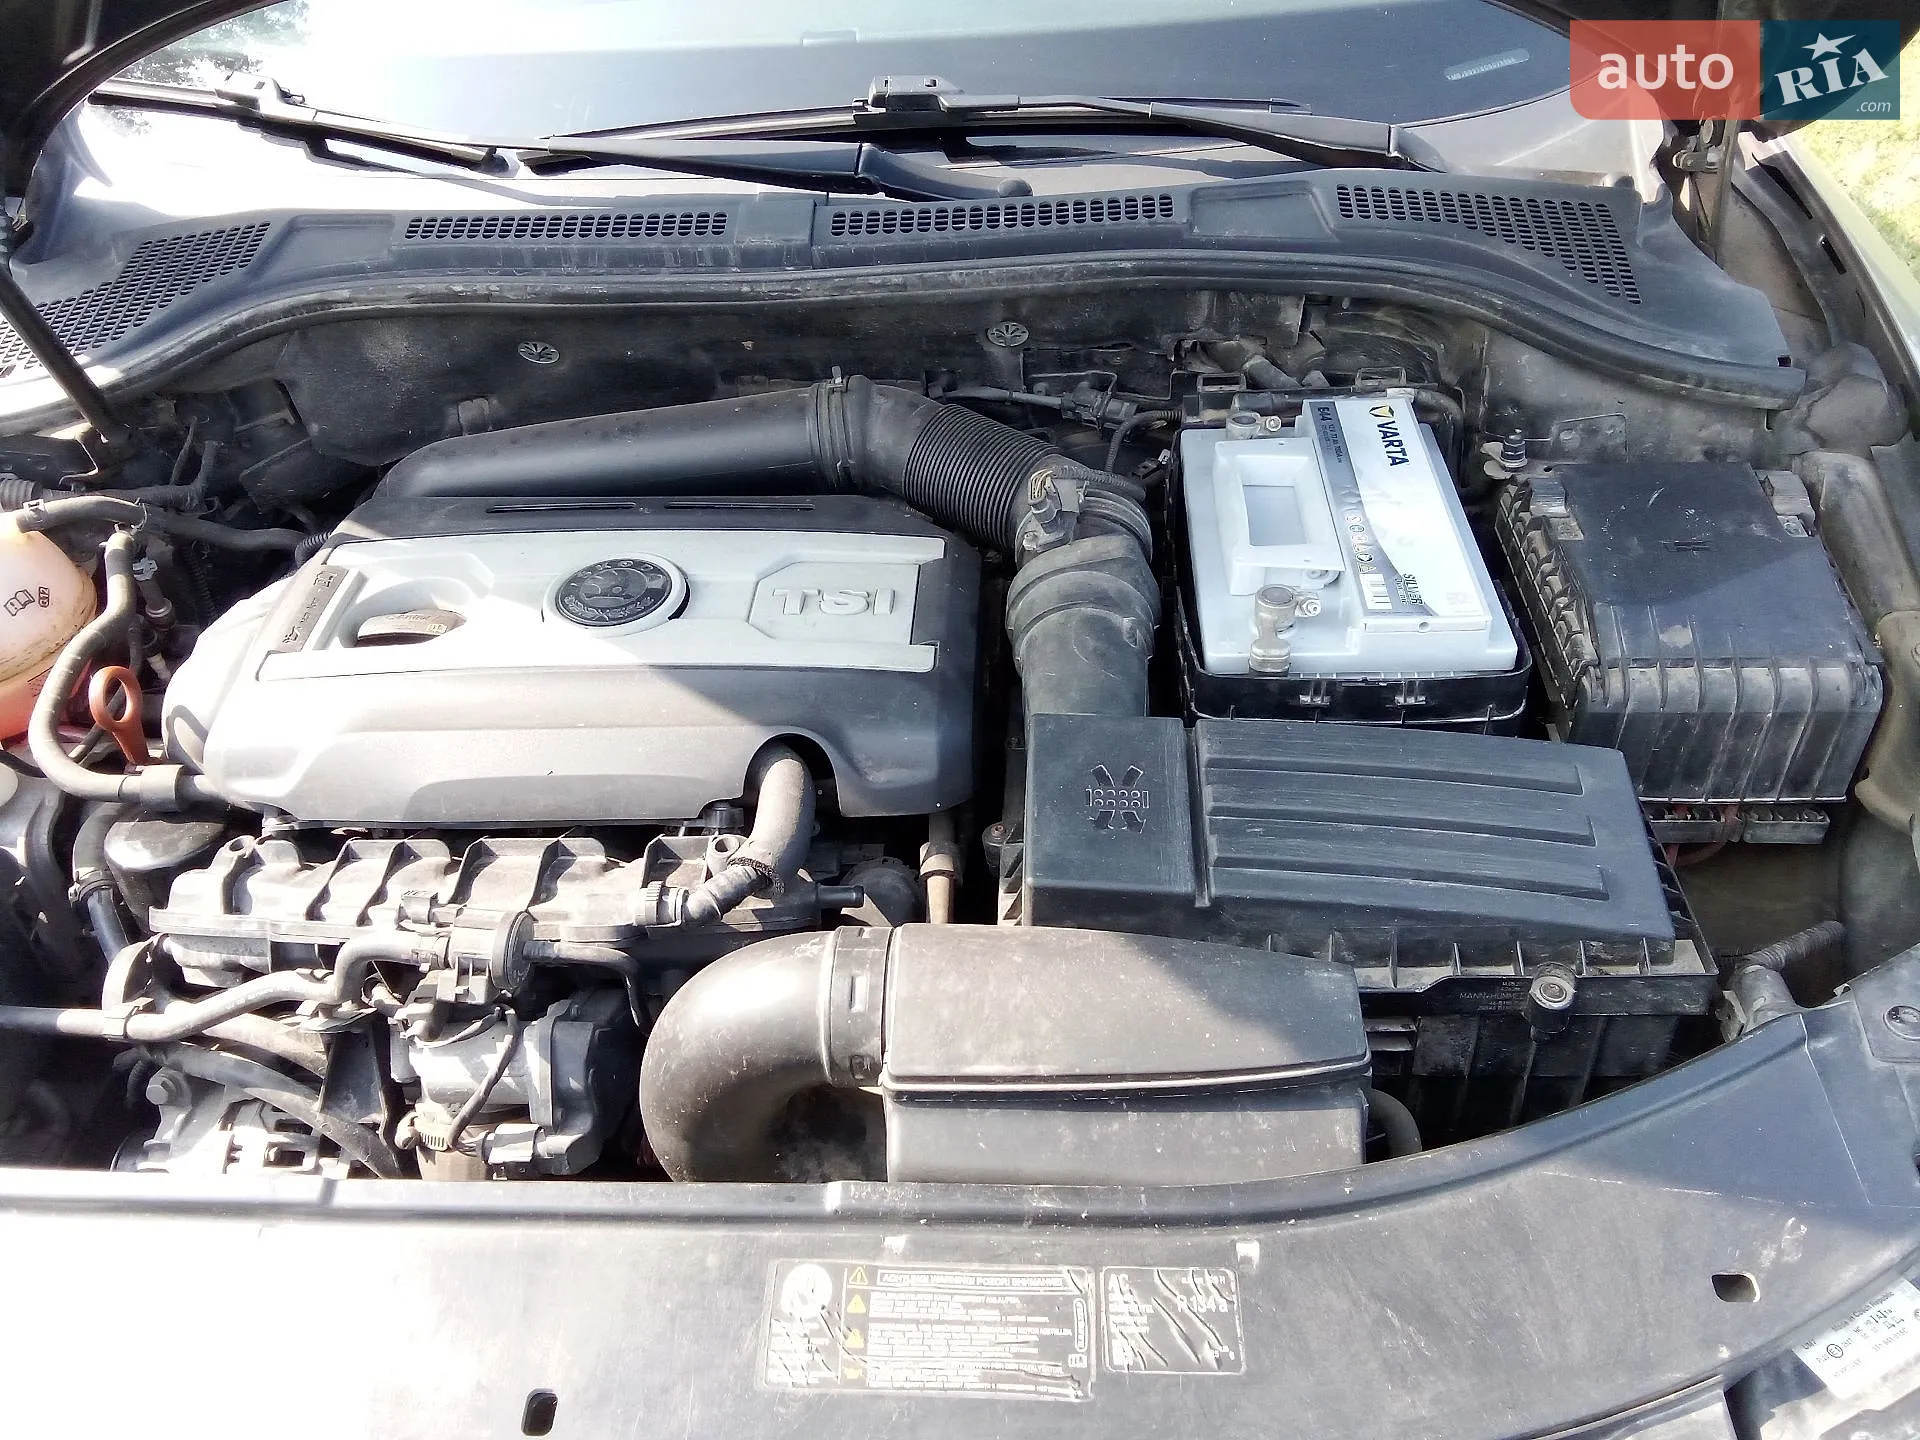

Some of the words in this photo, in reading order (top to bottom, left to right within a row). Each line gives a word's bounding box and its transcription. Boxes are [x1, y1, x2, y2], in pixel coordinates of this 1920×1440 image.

[1377, 420, 1409, 467] VARTA
[772, 588, 895, 615] TSI
[1404, 573, 1423, 604] SILVER
